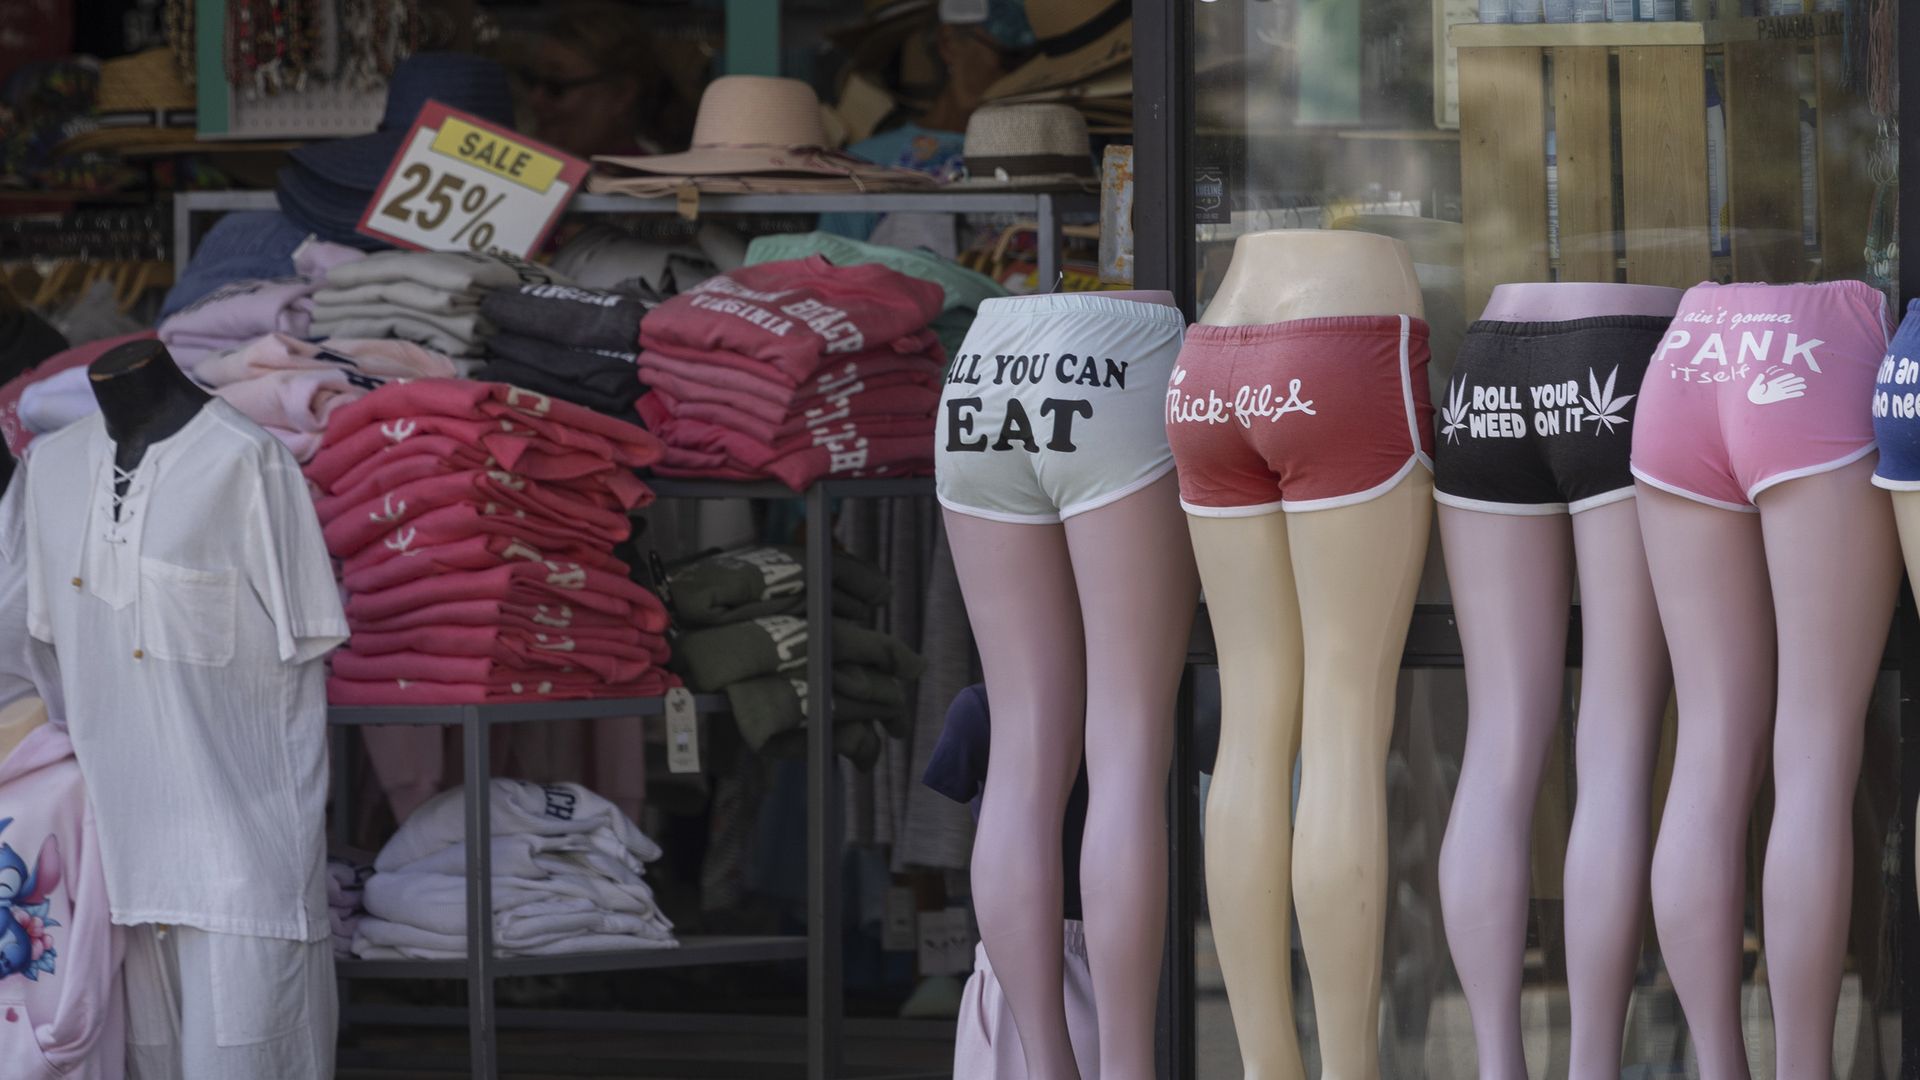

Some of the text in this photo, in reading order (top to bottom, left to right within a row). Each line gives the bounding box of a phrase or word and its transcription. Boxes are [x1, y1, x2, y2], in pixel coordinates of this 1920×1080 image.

[1758, 16, 1815, 40] PANAMA
[457, 132, 532, 177] SALE
[381, 162, 506, 251] 25%
[1683, 306, 1728, 325] ain't
[1730, 312, 1794, 330] gonna
[1657, 330, 1825, 374] PANK
[993, 353, 1050, 385] YOU
[1055, 353, 1129, 390] CAN
[1670, 363, 1751, 384] itself
[1472, 380, 1579, 411] ROLL YOUR
[946, 397, 1093, 454] EAT
[1469, 407, 1584, 438] WEED ON IT
